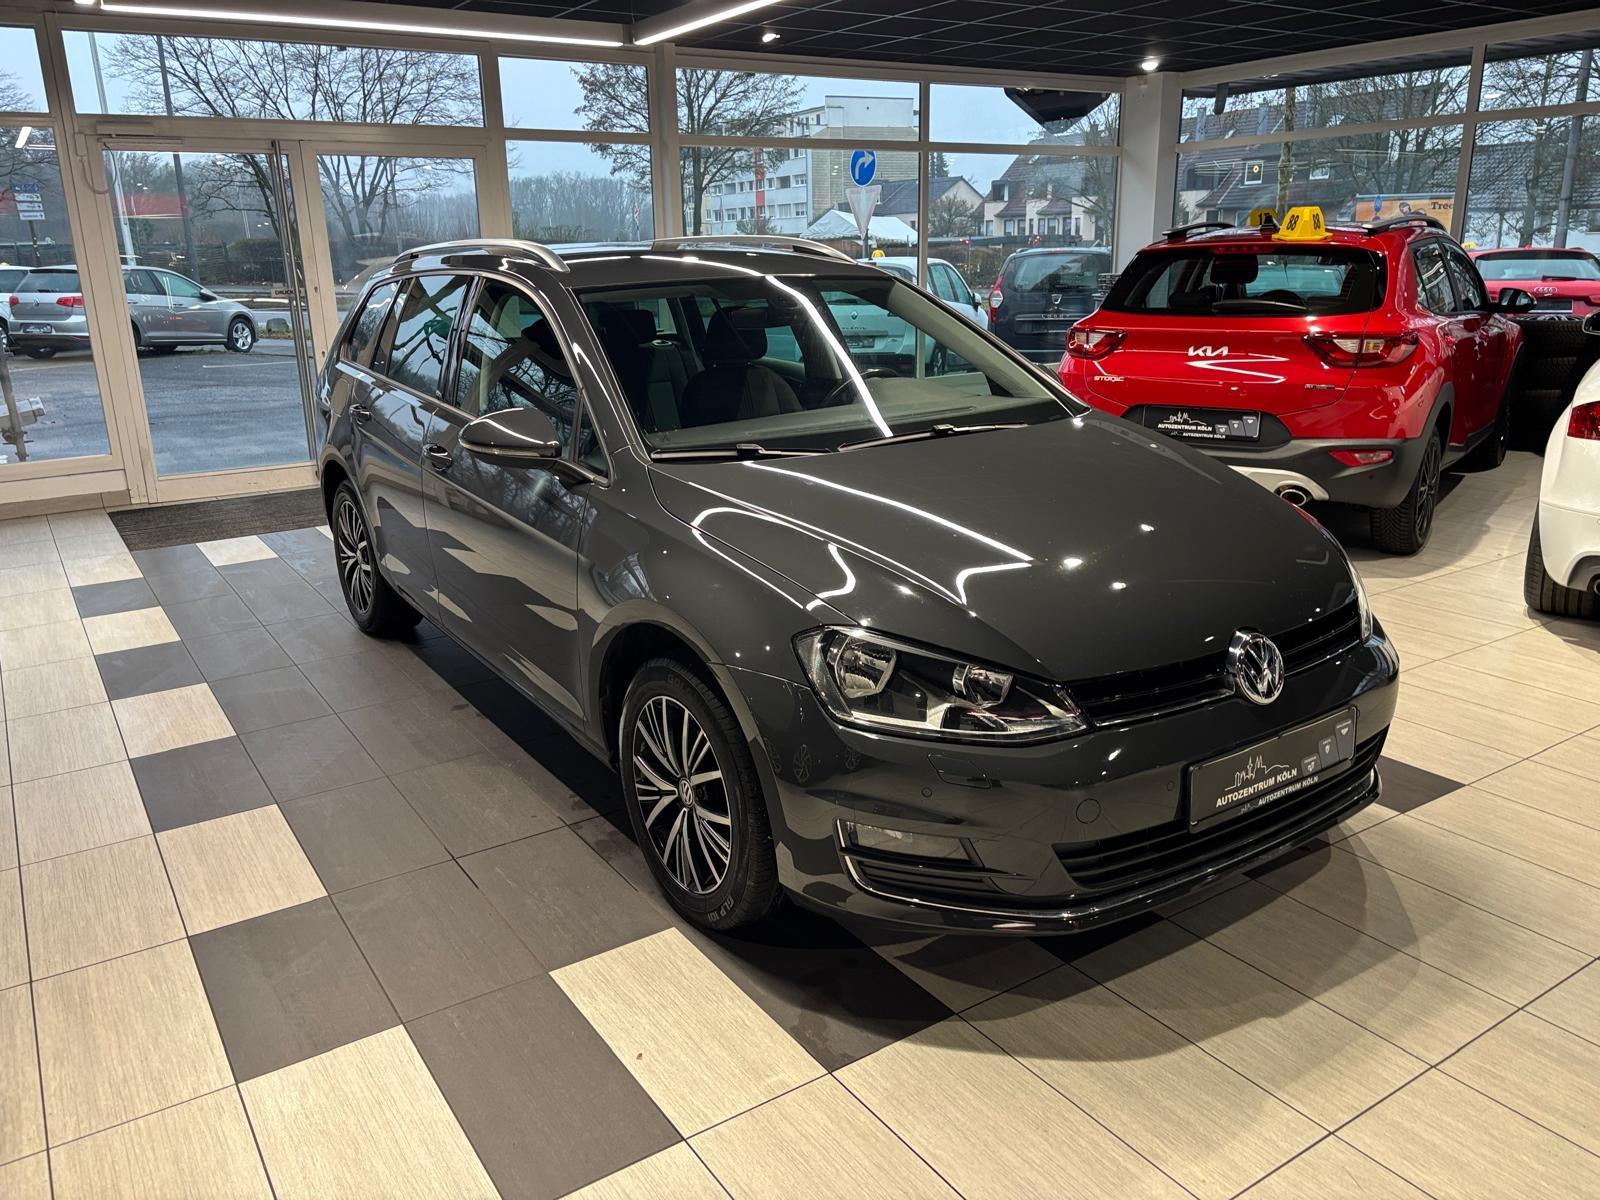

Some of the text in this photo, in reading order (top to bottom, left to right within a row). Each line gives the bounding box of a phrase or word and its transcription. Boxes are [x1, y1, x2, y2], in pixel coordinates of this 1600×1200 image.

[1286, 214, 1300, 231] 88
[1187, 345, 1229, 357] KIA
[1157, 423, 1197, 431] AUTOZENTRUM
[1216, 767, 1298, 808] AUTOZENTRUM KÖLN
[1258, 775, 1319, 806] AUTOZENTRUM KÖLN
